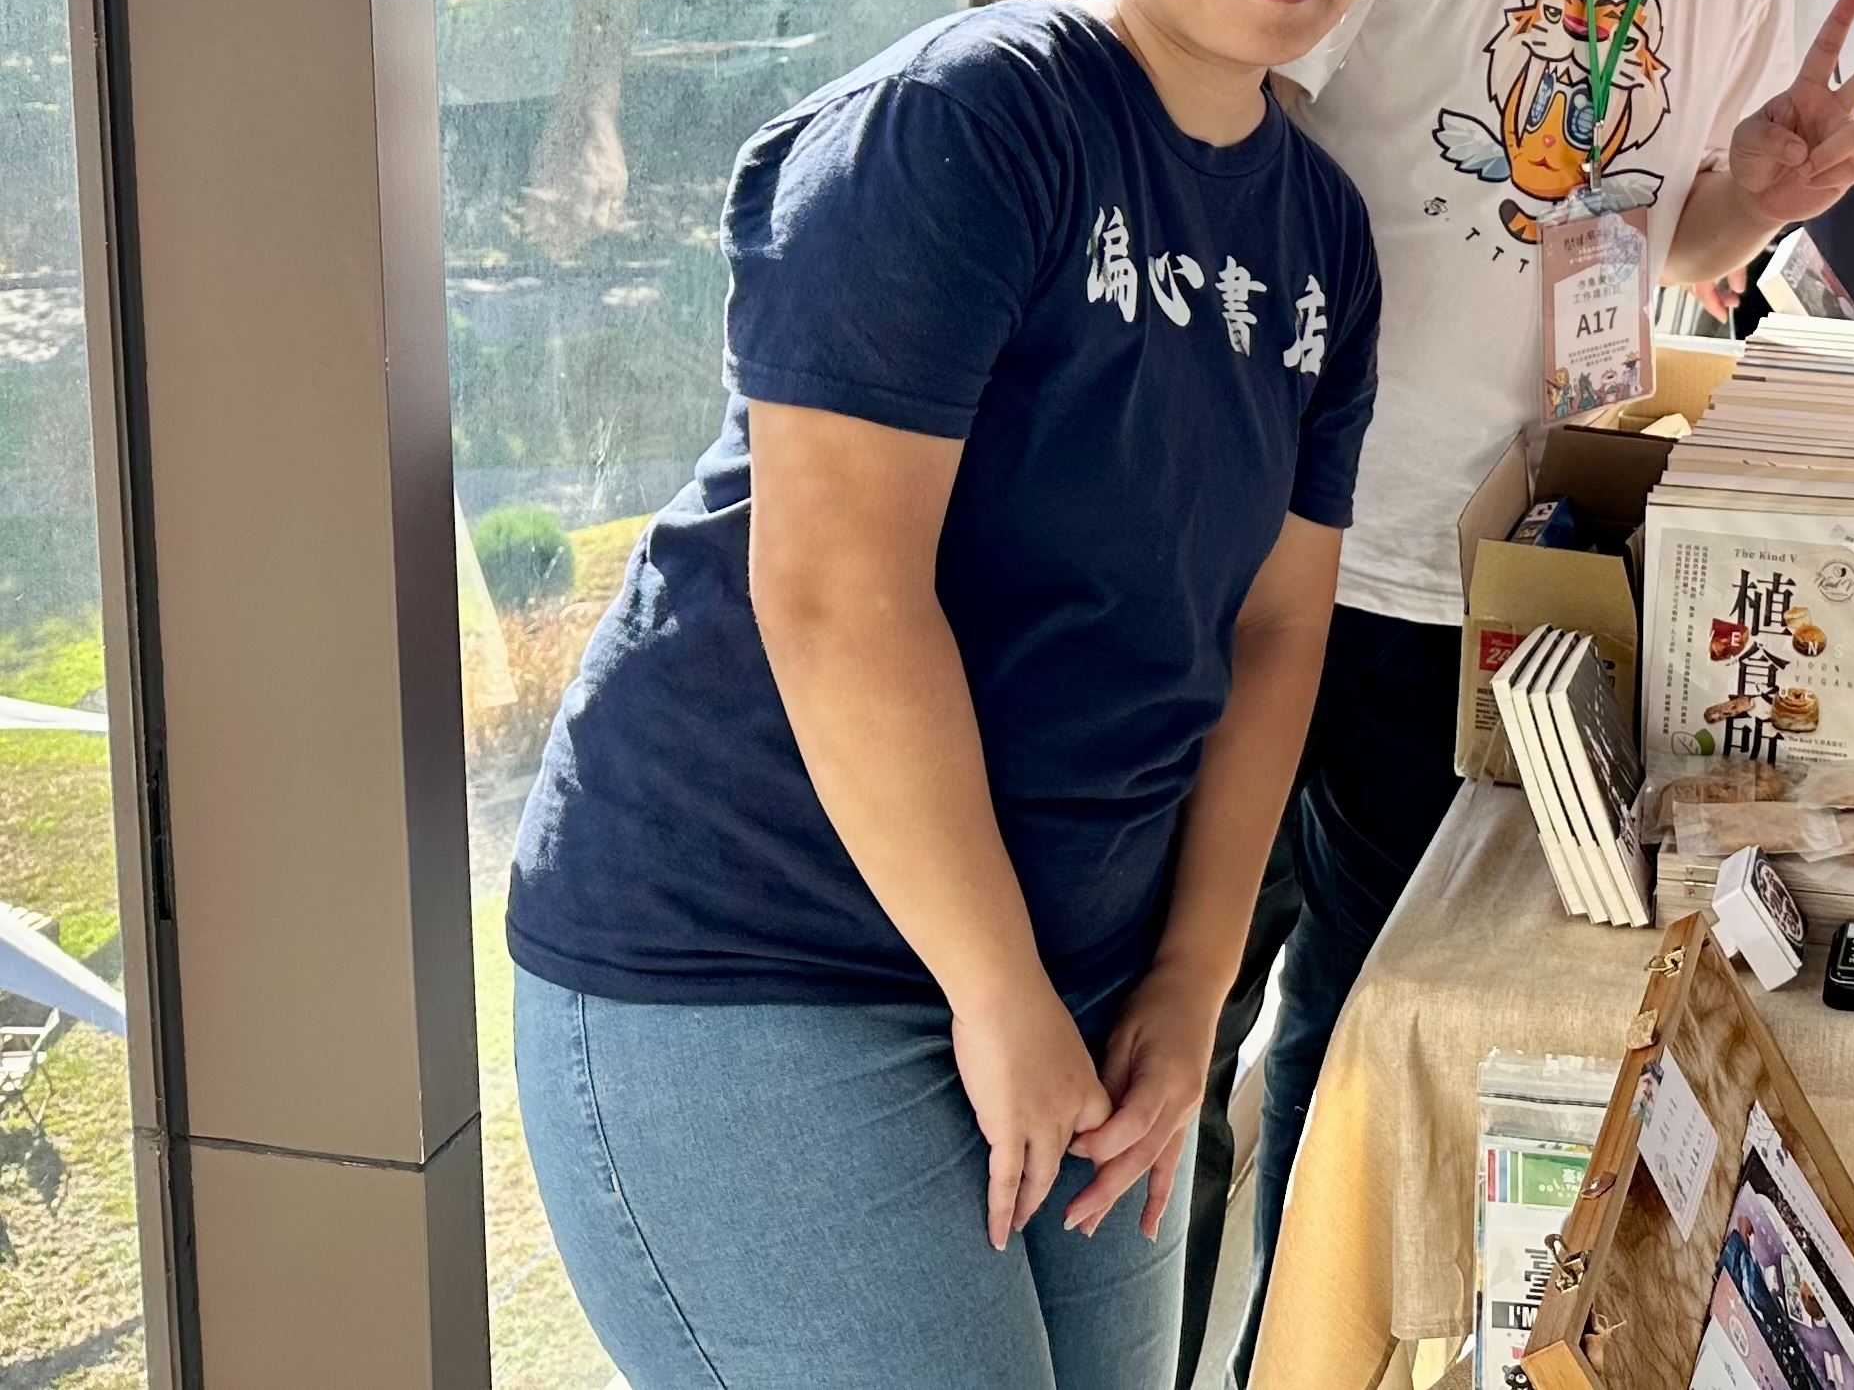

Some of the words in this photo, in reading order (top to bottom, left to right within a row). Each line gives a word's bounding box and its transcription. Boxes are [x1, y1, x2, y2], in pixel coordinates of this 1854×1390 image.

[1087, 206, 1328, 376] 偏心書店
[1576, 306, 1618, 339] A17
[1734, 548, 1755, 560] The
[1759, 551, 1785, 562] Kind
